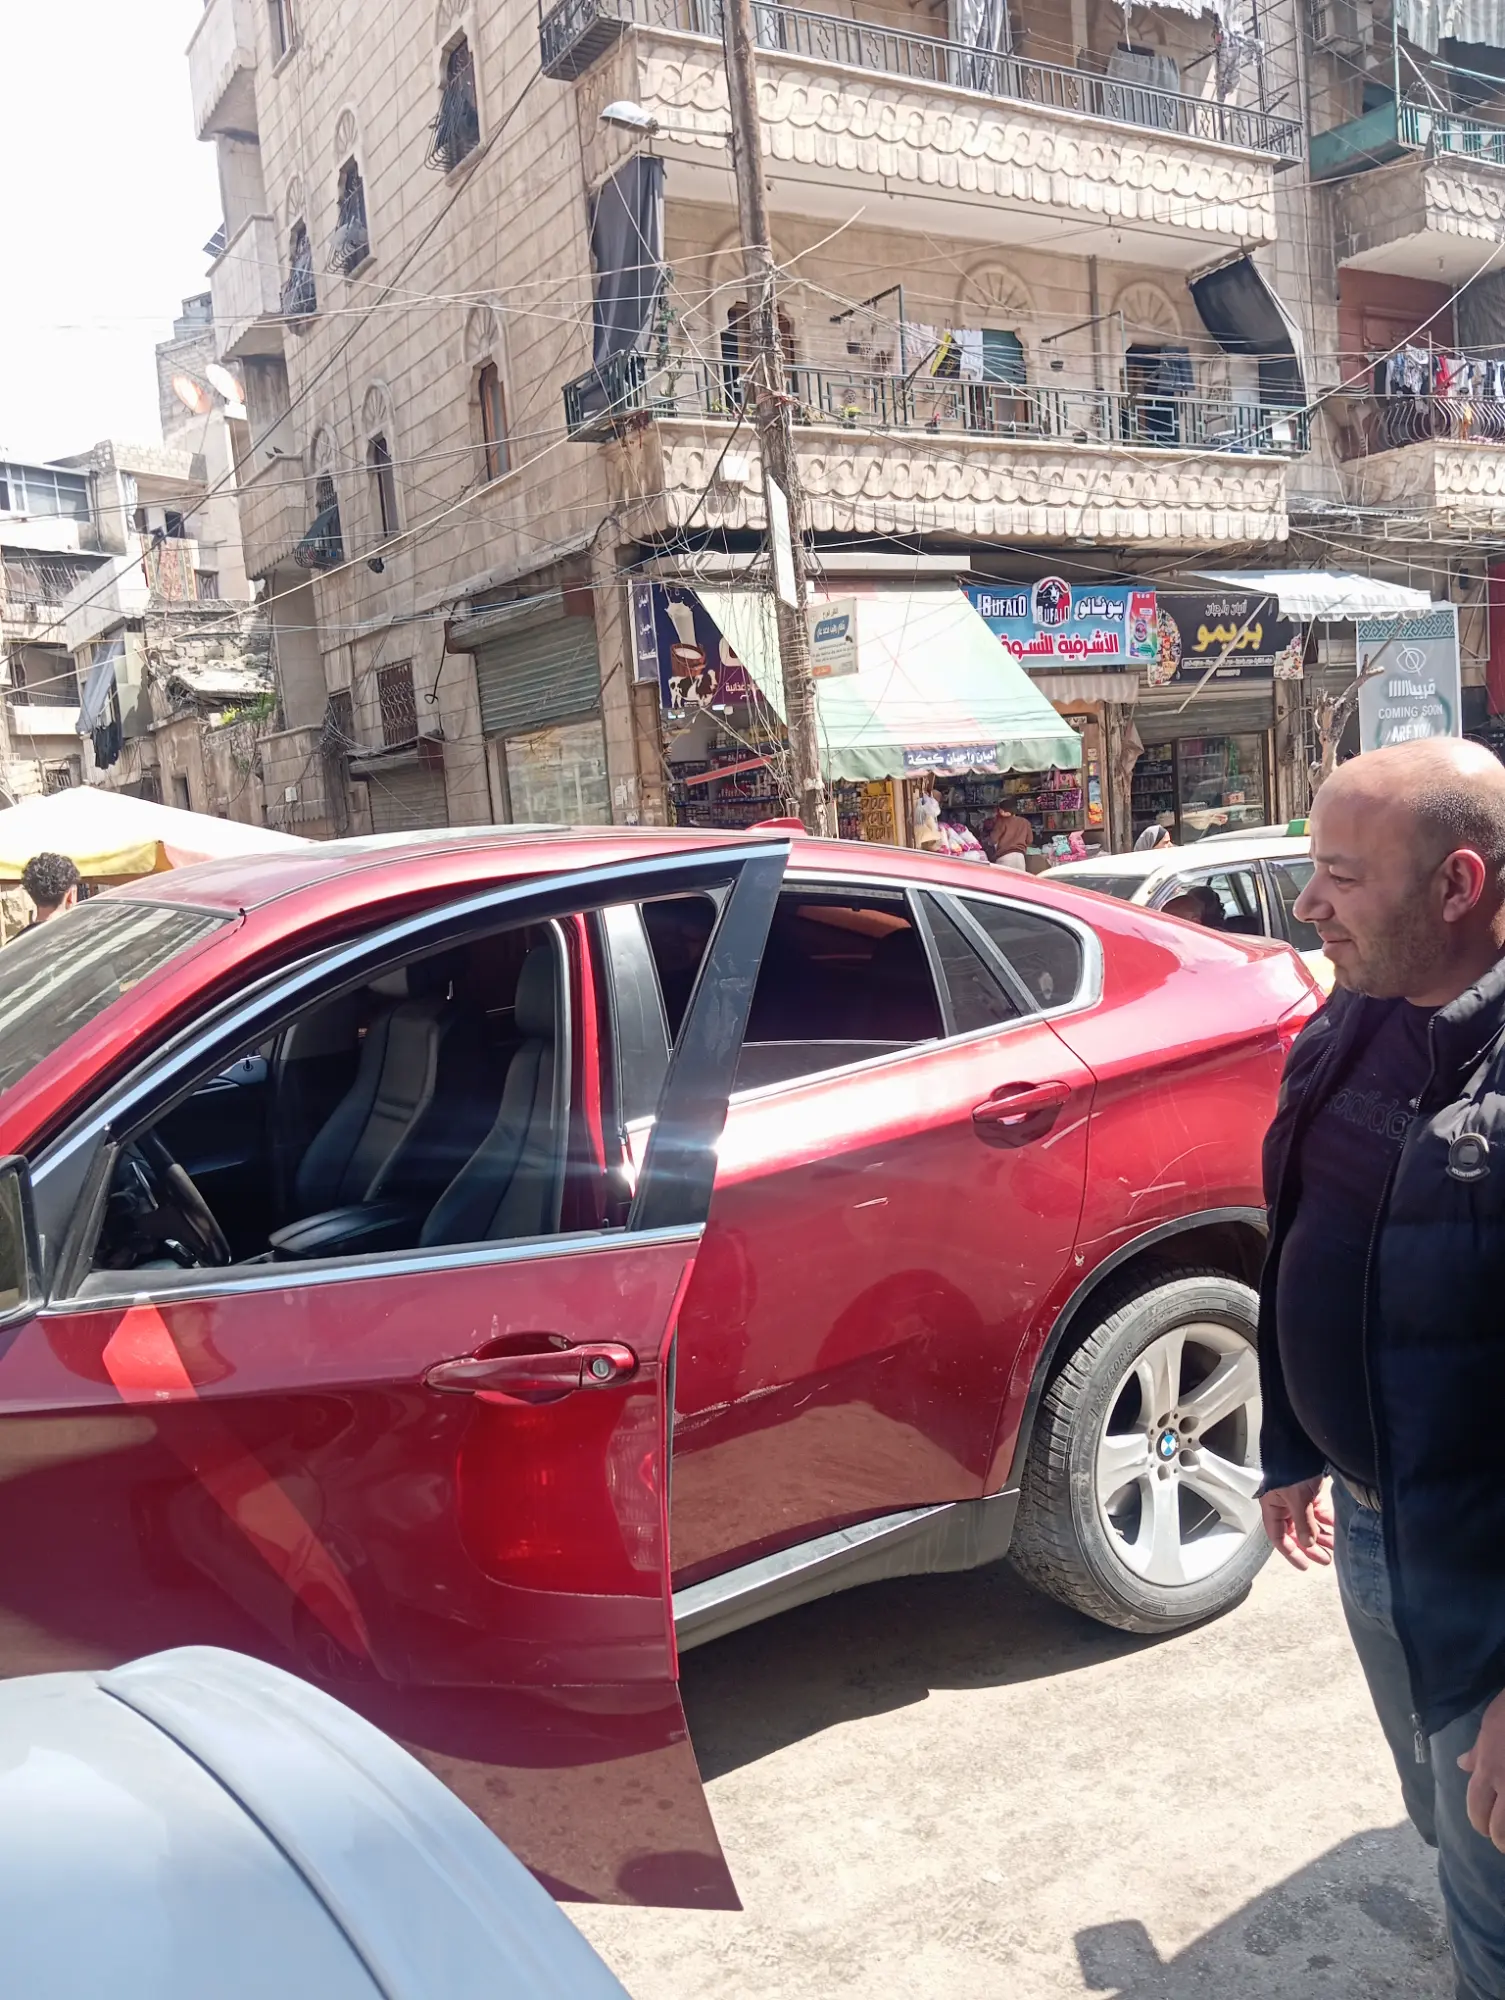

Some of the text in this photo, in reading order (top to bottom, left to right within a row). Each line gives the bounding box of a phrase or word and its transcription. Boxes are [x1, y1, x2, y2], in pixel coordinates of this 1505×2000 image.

[981, 594, 1028, 617] BUFALO
[1077, 596, 1125, 620] بوفالو
[1057, 630, 1119, 660] الأشرفية
[1191, 622, 1264, 652] بريمو
[1378, 704, 1443, 719] COMING SOON
[908, 753, 945, 766] كعكة
